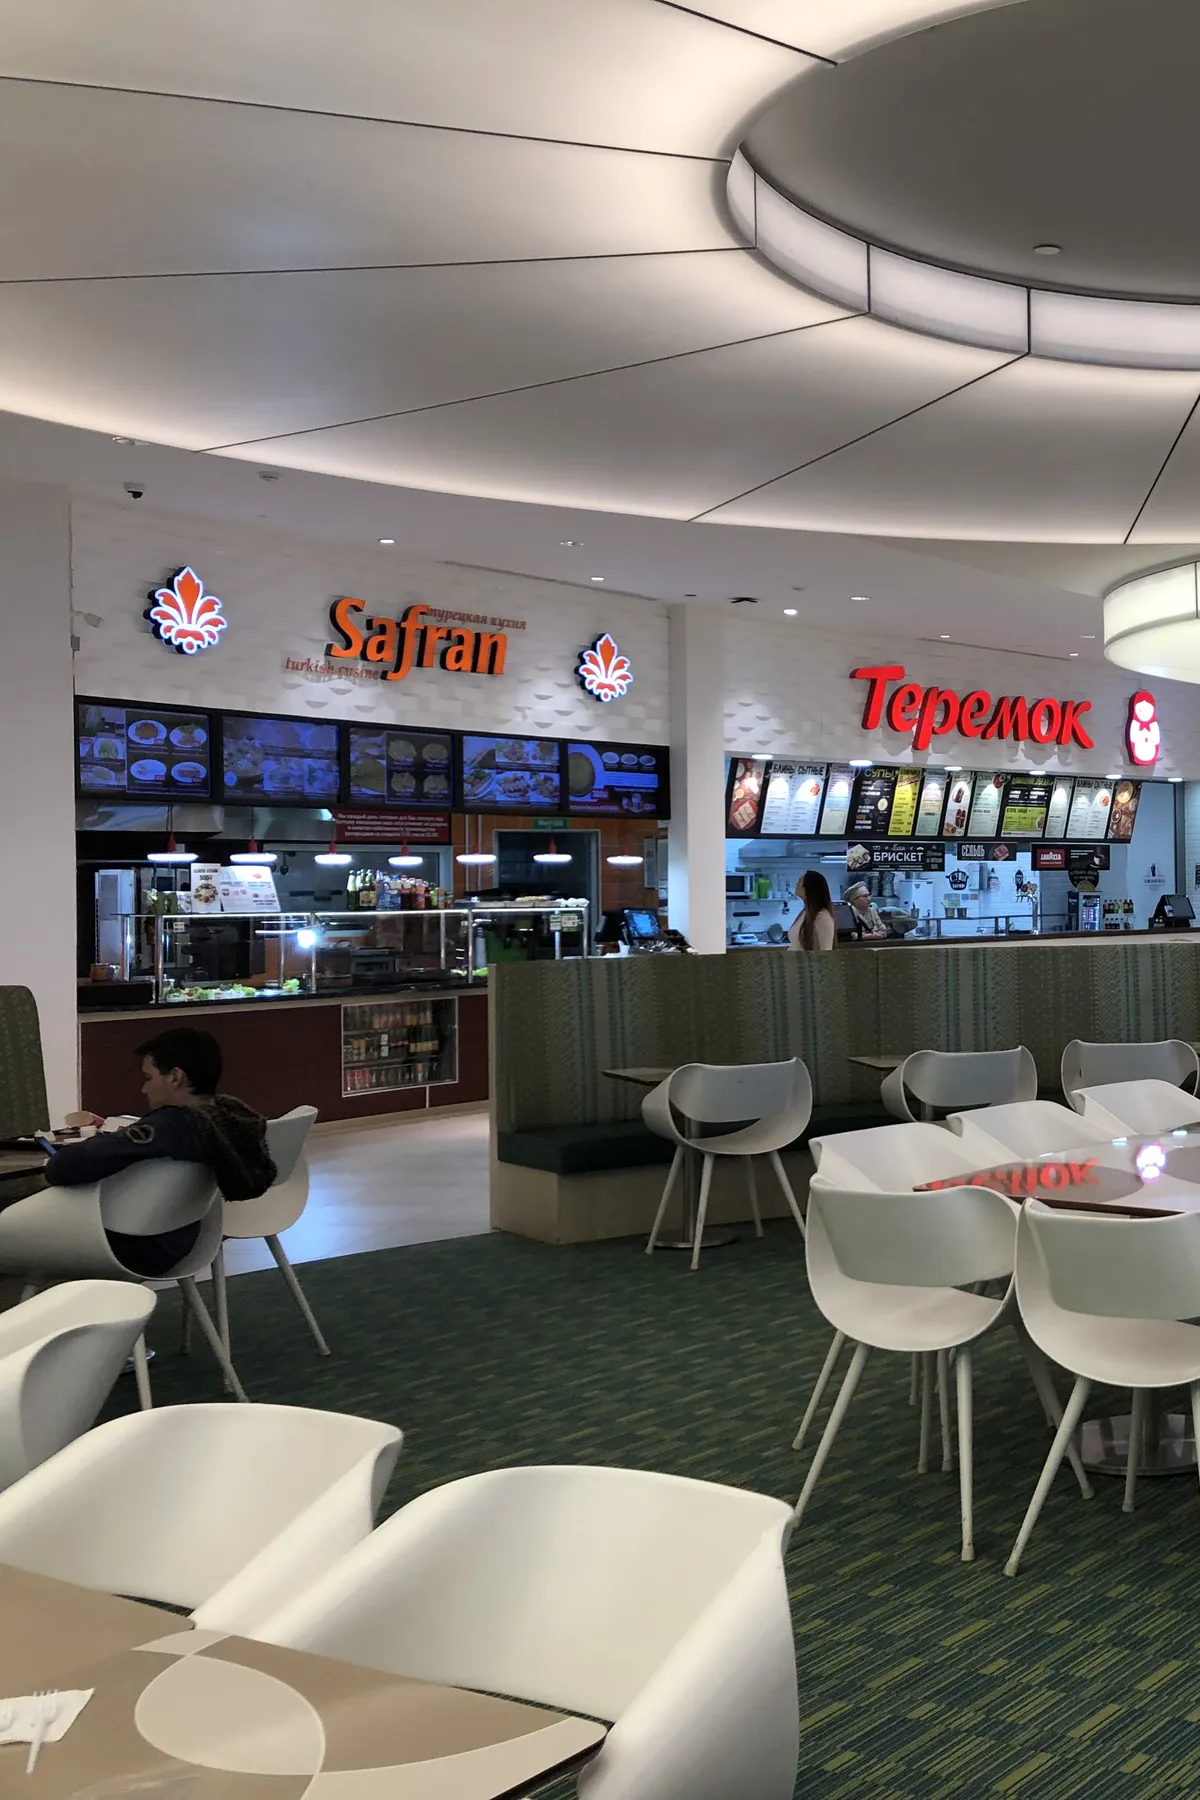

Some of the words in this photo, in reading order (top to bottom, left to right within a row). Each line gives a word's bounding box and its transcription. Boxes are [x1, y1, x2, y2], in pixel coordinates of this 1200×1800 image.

[490, 615, 527, 631] кухня
[326, 596, 509, 681] Safran
[284, 656, 334, 675] turkish
[849, 665, 1095, 751] Теремок
[798, 765, 825, 776] СЫТНЫЕ
[864, 768, 895, 779] СУПЫ
[873, 851, 924, 863] БРИСКЕТ
[961, 844, 985, 857] СЕЛЬДЬ
